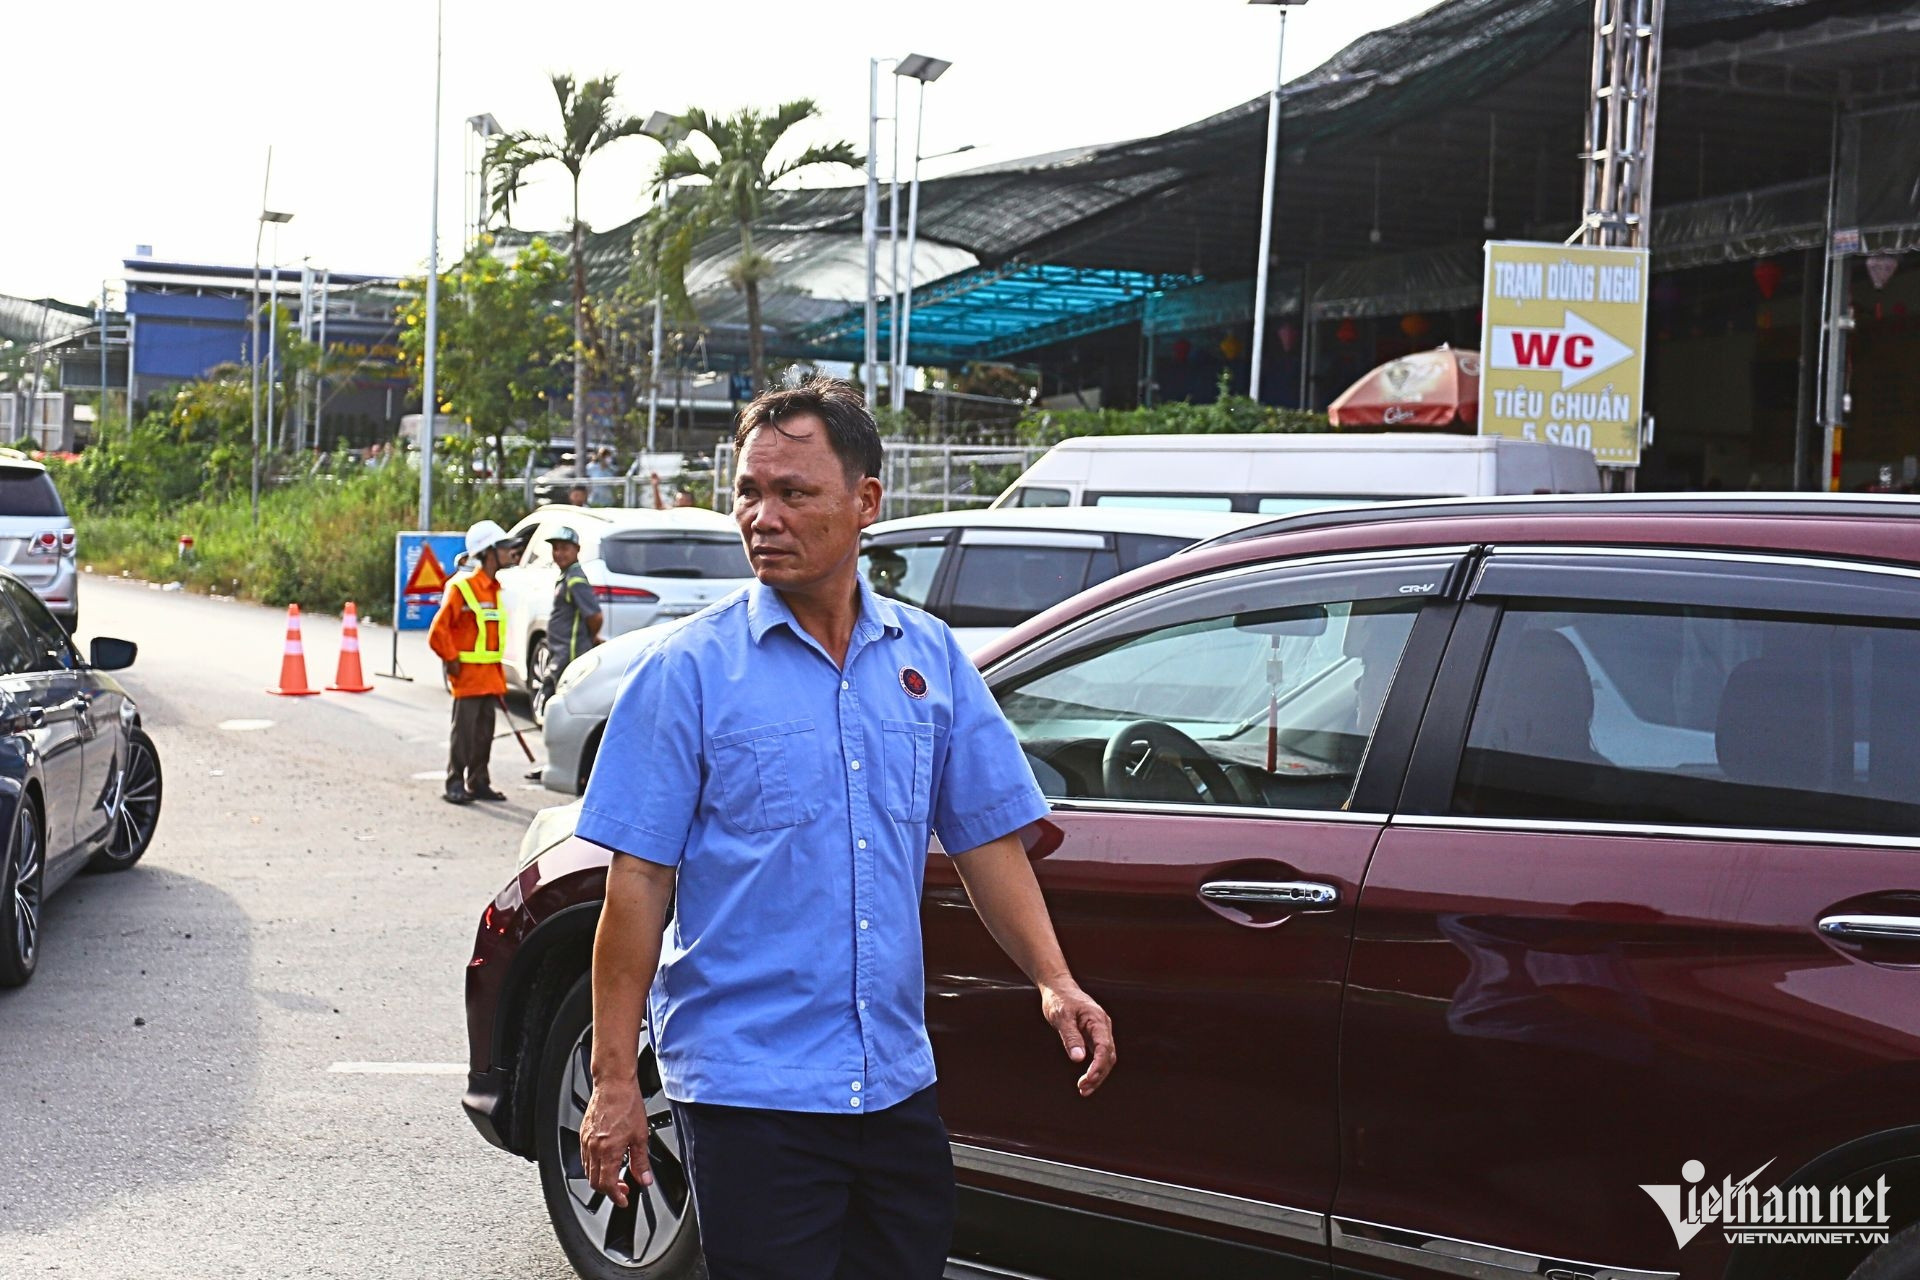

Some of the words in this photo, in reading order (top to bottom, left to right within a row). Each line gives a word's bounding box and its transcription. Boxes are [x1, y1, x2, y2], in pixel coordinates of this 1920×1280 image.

[1494, 262, 1542, 306] TRẠM
[1547, 258, 1596, 301] DỪNG
[1599, 256, 1641, 303] NGHỈ
[1511, 332, 1594, 369] WC
[1493, 384, 1544, 419] TIÊU
[1521, 421, 1537, 442] 5
[1398, 583, 1435, 594] CR-V
